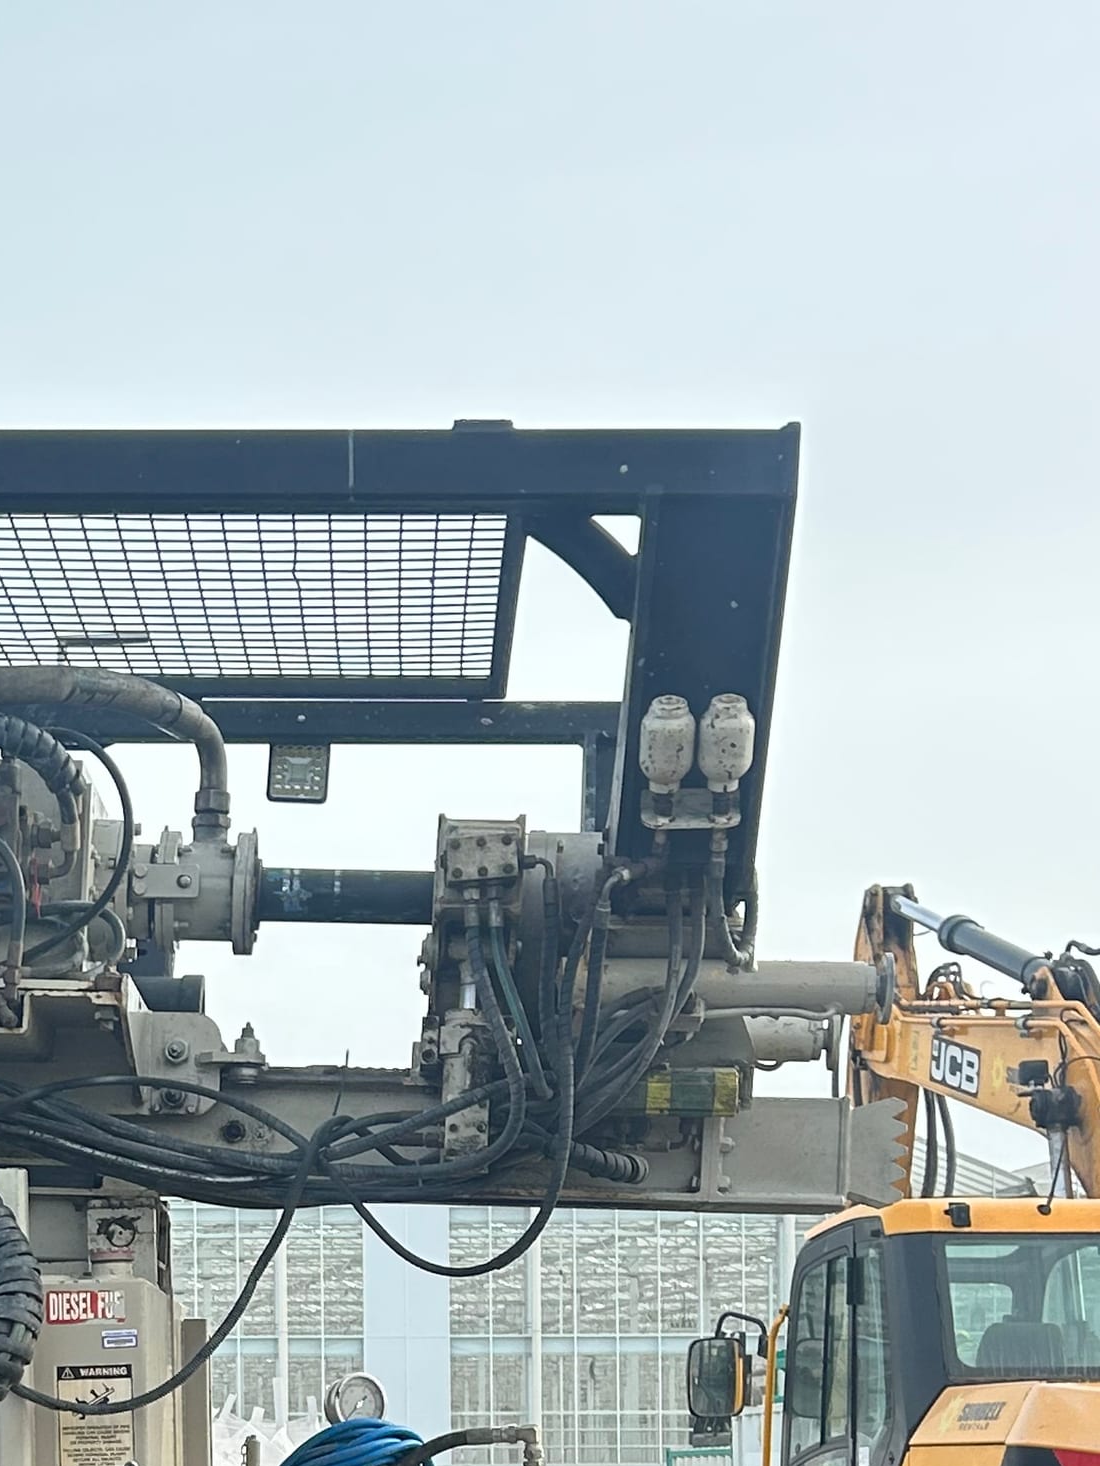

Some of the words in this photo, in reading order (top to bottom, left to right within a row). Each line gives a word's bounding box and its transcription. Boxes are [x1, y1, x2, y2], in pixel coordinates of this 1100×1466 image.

[930, 1039, 980, 1094] JCB
[49, 1292, 95, 1322] DIESEL
[79, 1366, 128, 1377] WARNING
